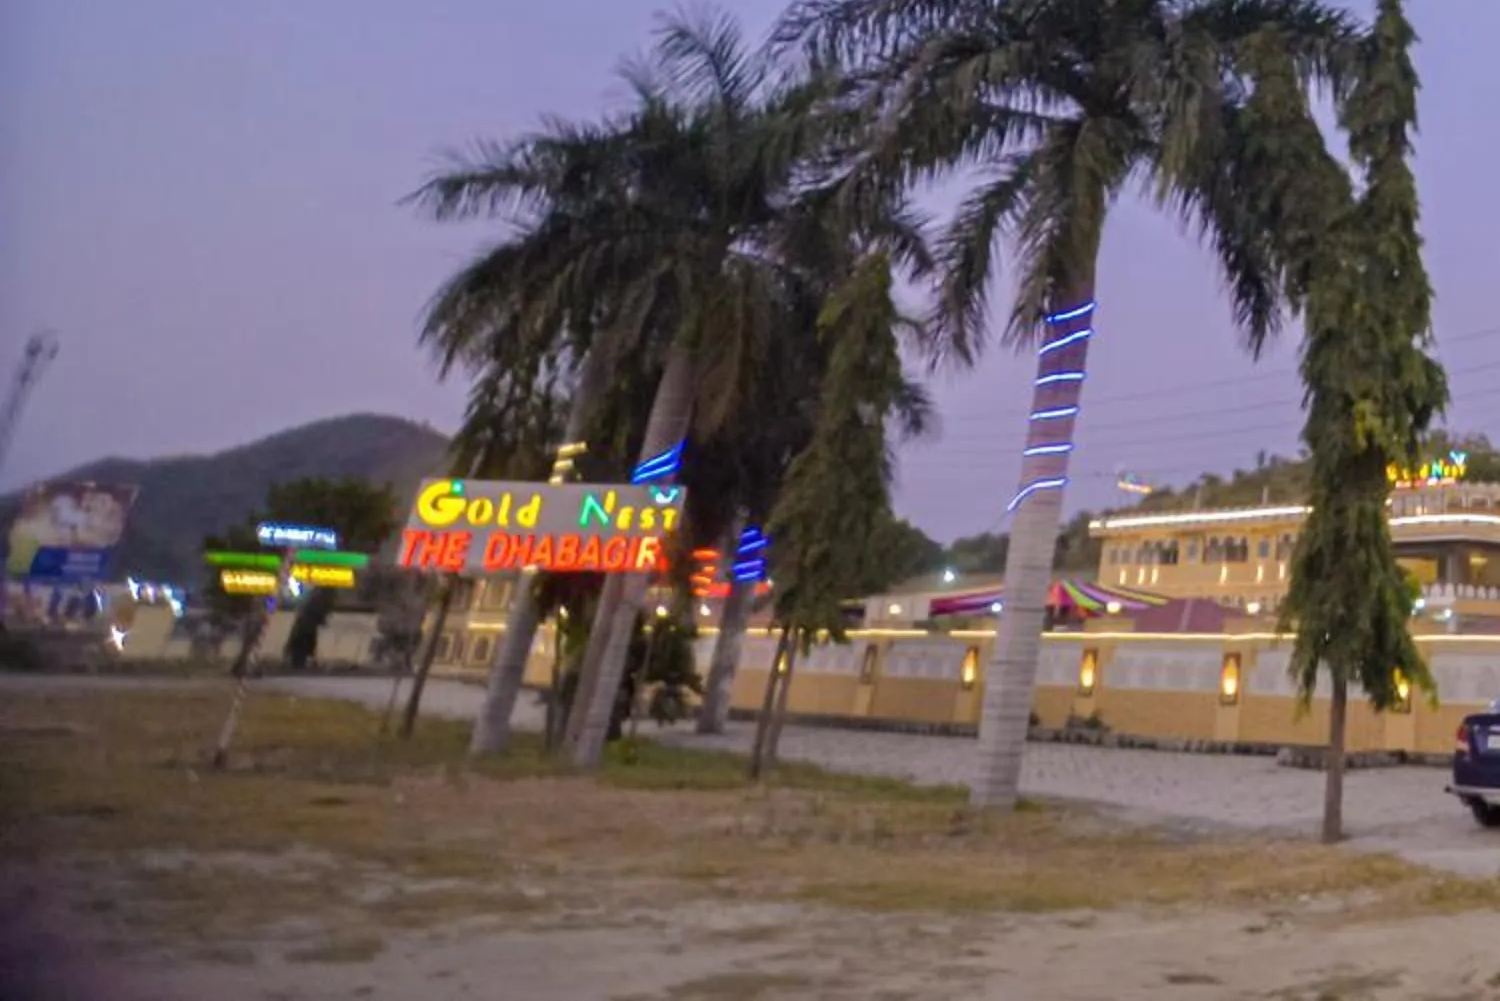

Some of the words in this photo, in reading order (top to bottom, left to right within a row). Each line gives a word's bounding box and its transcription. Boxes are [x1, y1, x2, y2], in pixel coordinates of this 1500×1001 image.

[417, 478, 541, 528] Gold
[402, 529, 472, 570] THE
[483, 530, 669, 570] DHABAGIR
